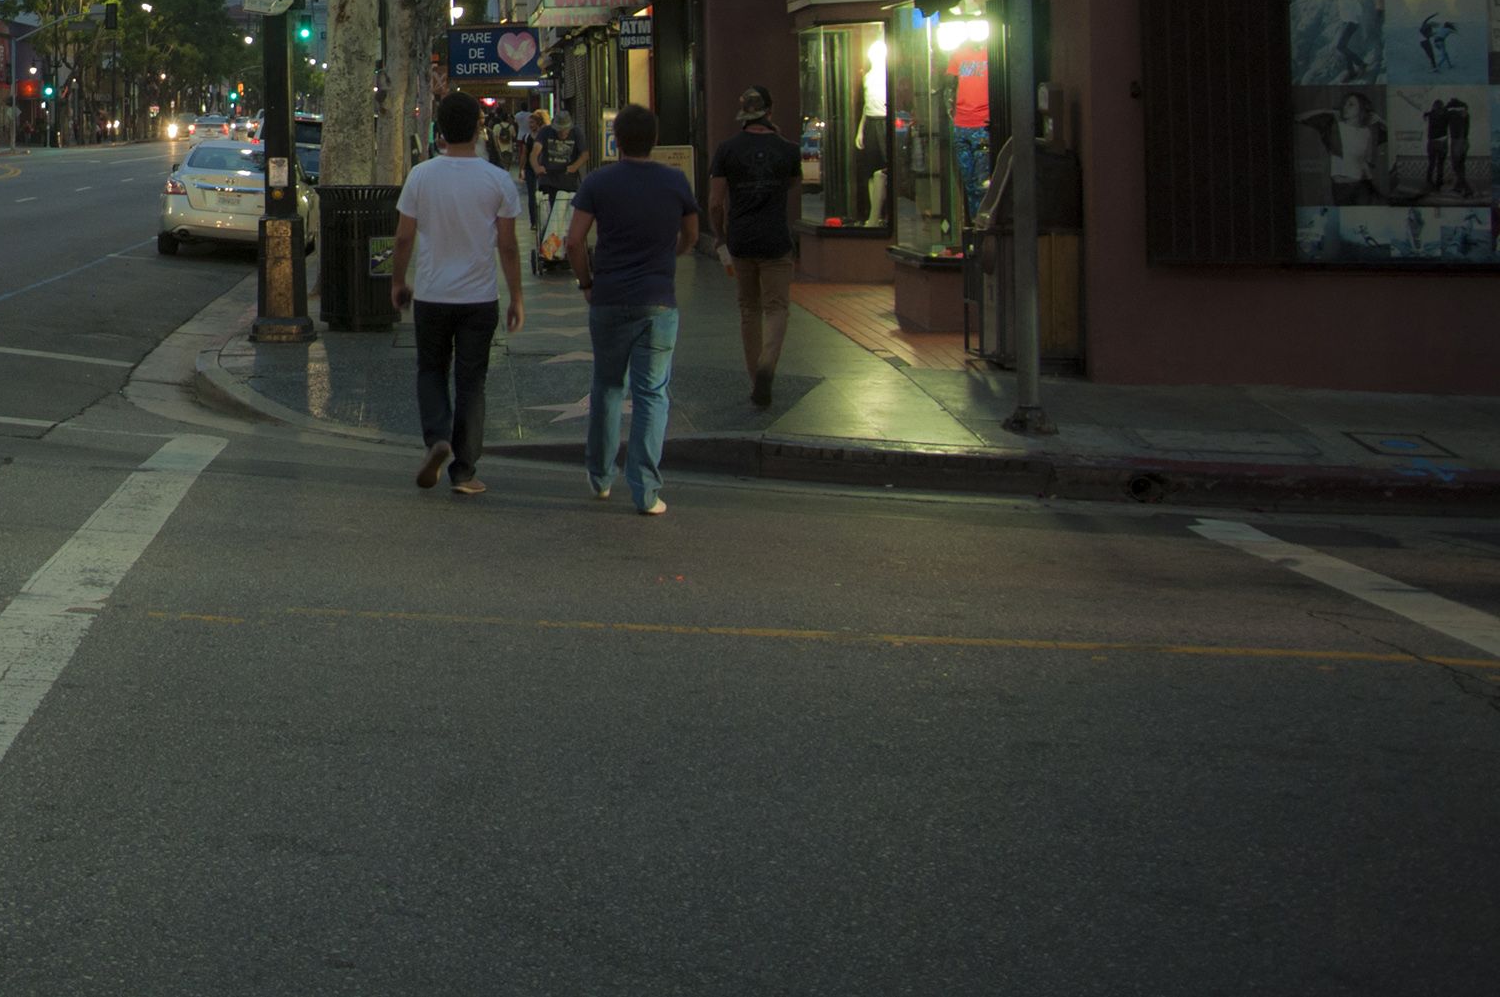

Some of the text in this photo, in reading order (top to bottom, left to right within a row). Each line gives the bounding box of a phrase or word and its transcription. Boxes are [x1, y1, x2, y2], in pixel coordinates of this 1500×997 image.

[620, 20, 651, 35] ATM
[460, 32, 492, 44] PARE
[468, 48, 485, 59] DE
[455, 63, 500, 76] SUFRIR
